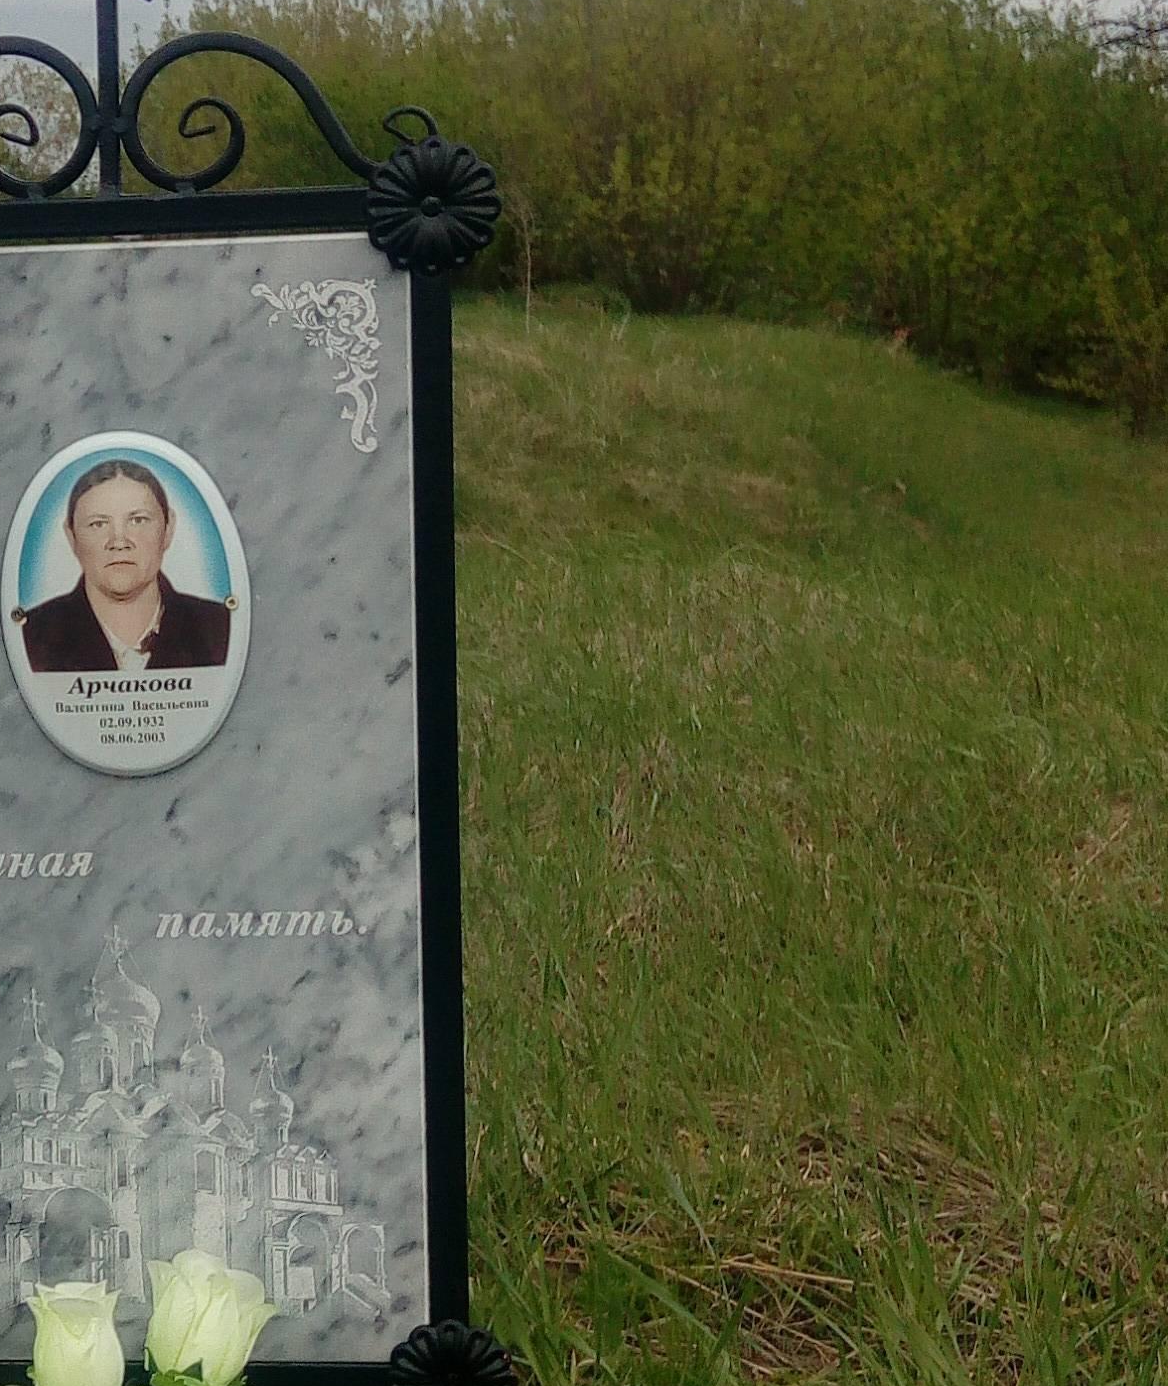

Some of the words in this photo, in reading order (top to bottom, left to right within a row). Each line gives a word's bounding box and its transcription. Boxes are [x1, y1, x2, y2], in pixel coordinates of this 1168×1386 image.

[67, 676, 193, 699] Арчакова
[55, 701, 125, 714] Валентина
[132, 699, 210, 712] Васильевна
[99, 715, 165, 729] 02.09.1932
[100, 732, 166, 745] 08.06.2003
[156, 909, 368, 940] память.
